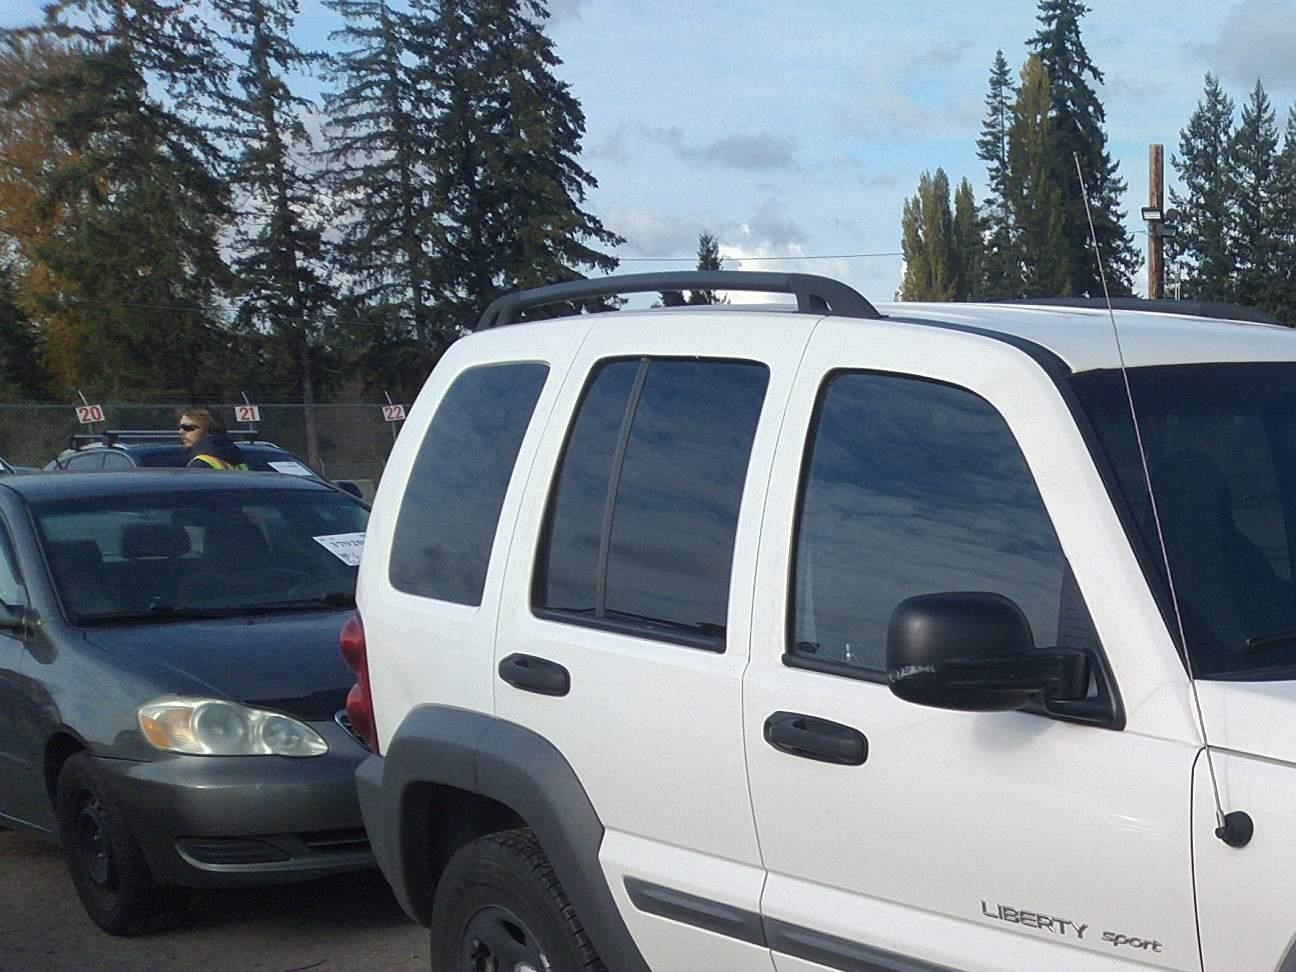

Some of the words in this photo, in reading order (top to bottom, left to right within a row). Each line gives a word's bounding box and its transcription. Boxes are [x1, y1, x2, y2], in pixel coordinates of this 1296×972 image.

[79, 406, 102, 421] 20
[239, 407, 256, 420] 21
[385, 406, 404, 419] 22
[981, 900, 1088, 939] LIBERTY
[1101, 930, 1163, 953] sport
